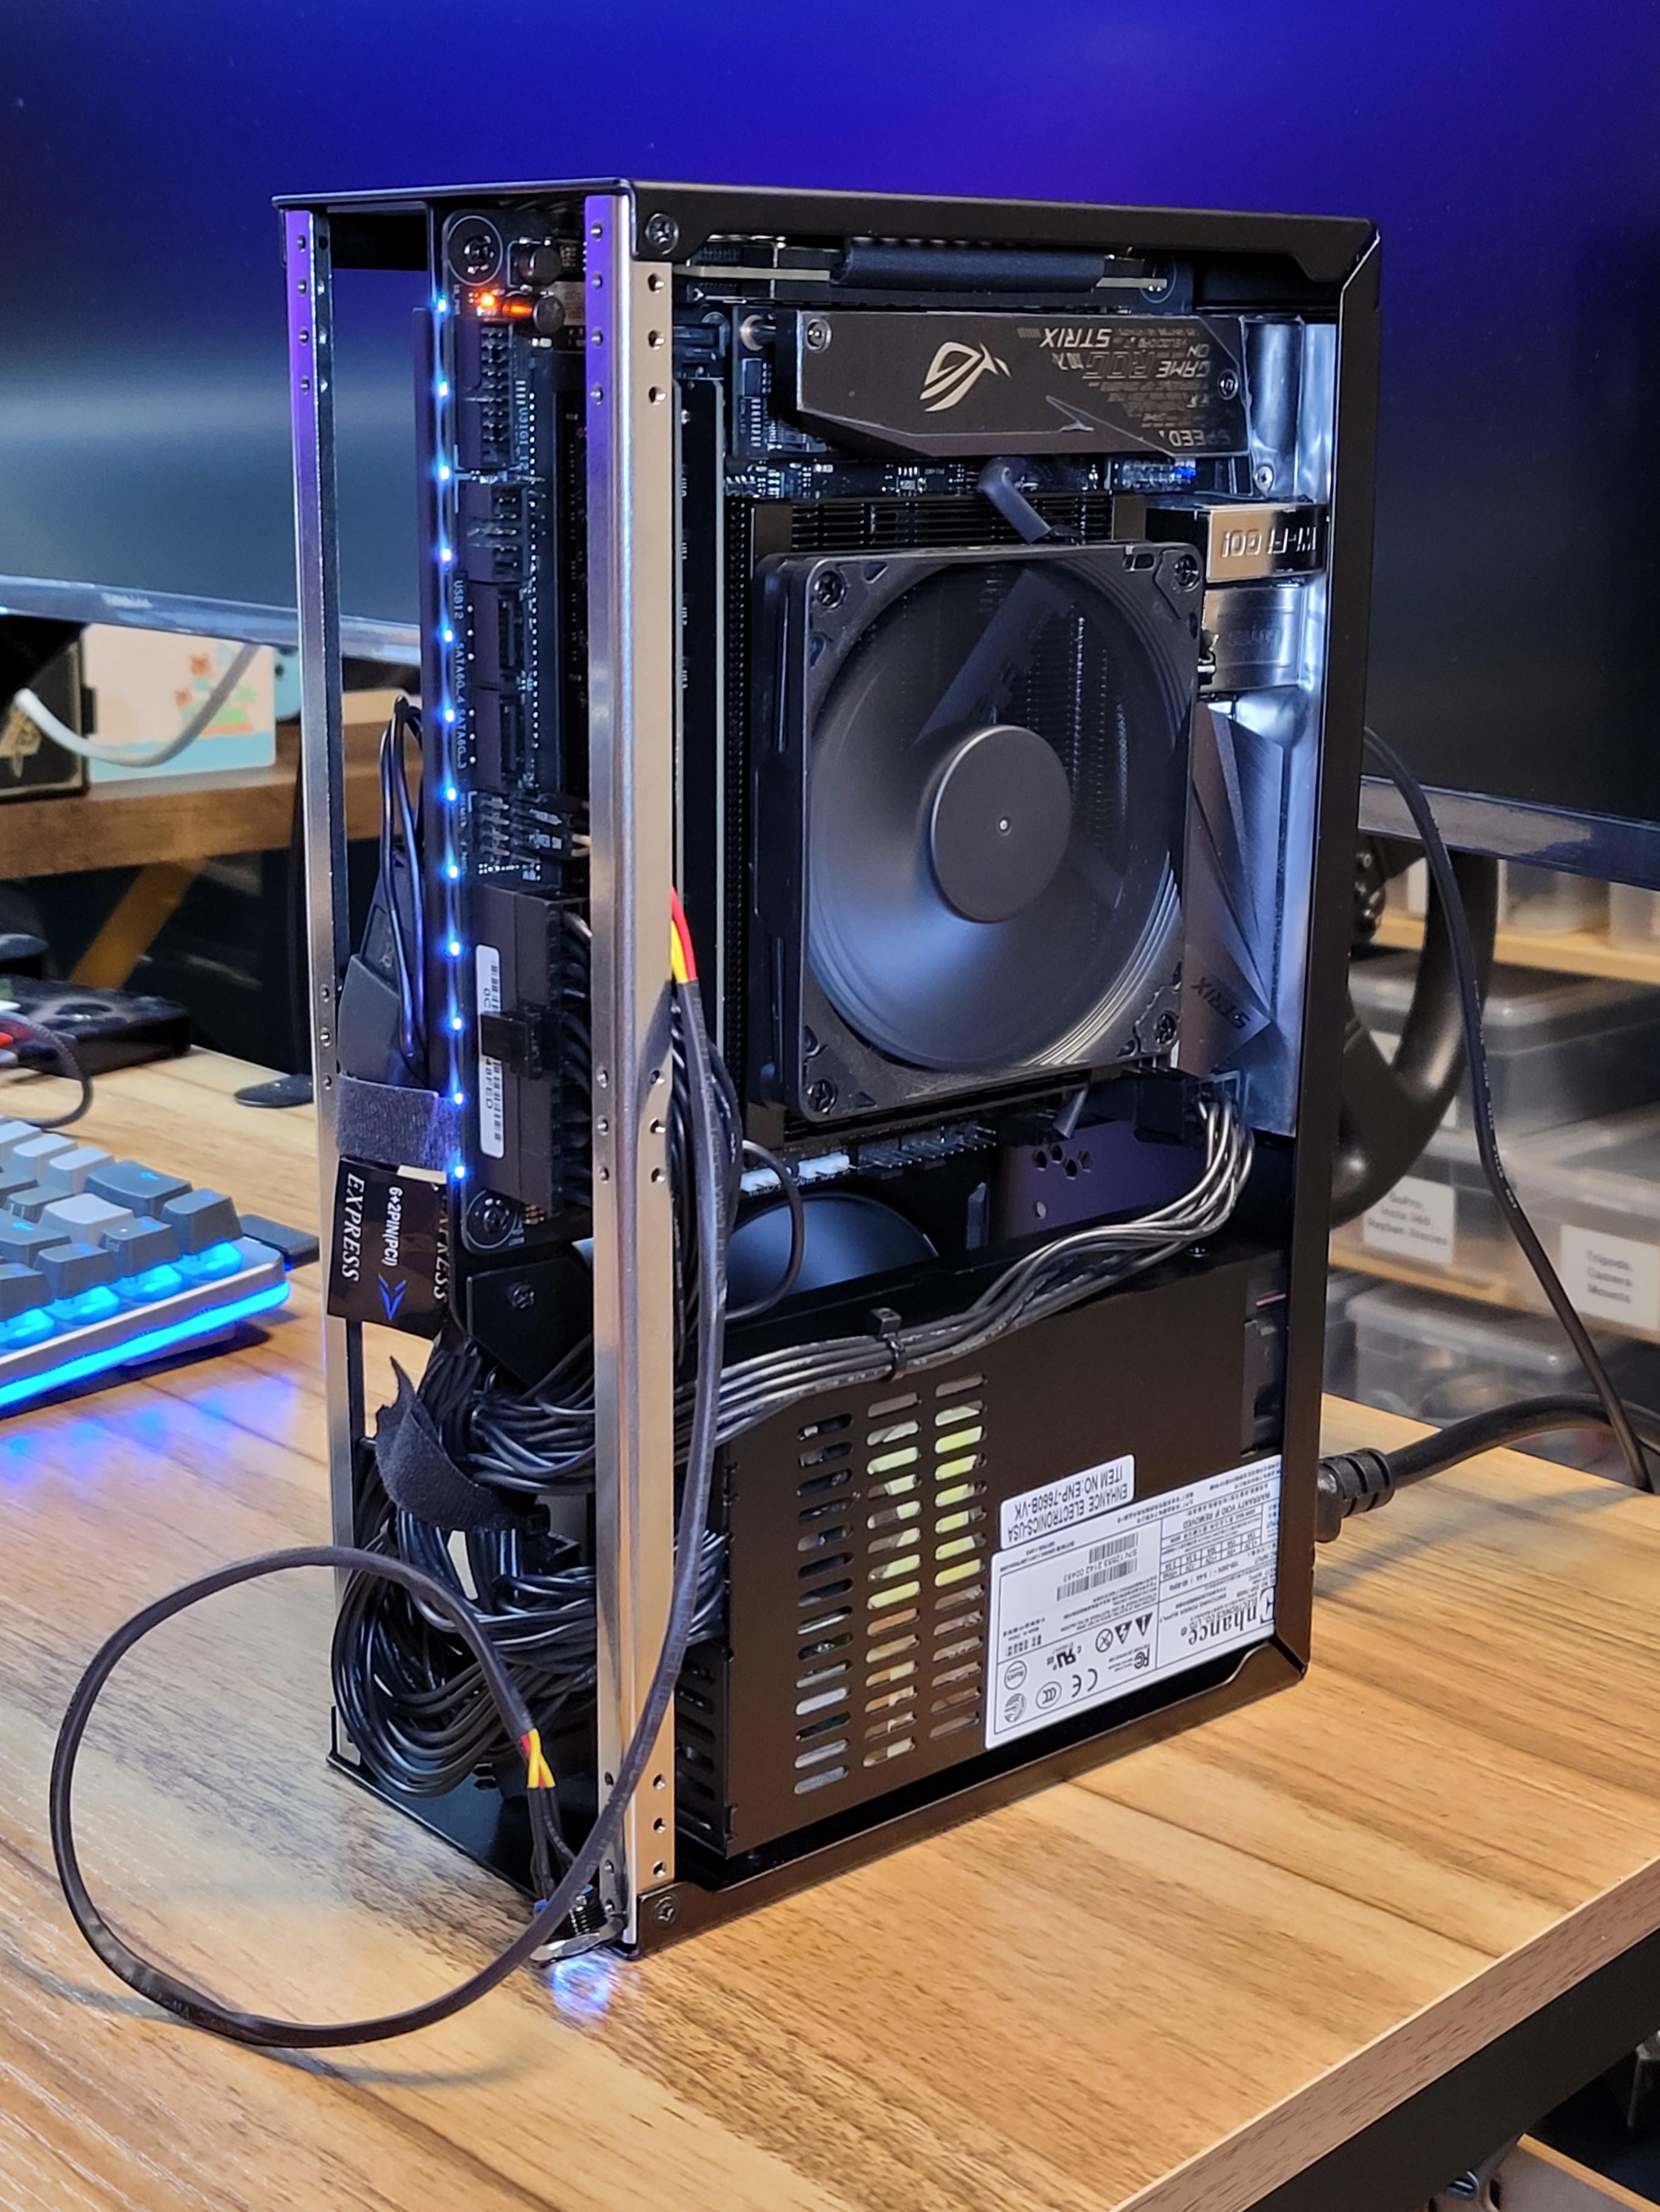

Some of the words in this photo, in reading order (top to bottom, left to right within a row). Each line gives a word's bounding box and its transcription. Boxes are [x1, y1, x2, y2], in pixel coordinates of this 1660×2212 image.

[1039, 328, 1112, 348] STRIX
[1187, 344, 1210, 358] ON
[1082, 351, 1155, 379] ROG
[1155, 360, 1210, 378] GAME
[1222, 530, 1262, 558] GO!
[453, 580, 464, 619] USB12
[1190, 977, 1251, 1029] STRIX
[341, 1173, 364, 1282] EXPRESS
[381, 1186, 403, 1266] 6+2PIN(PCI)
[1100, 1466, 1122, 1488] ITEM
[1088, 1483, 1127, 1512] ENHANCE
[1183, 1513, 1213, 1529] REMOVED
[1188, 1587, 1274, 1645] Enhance
